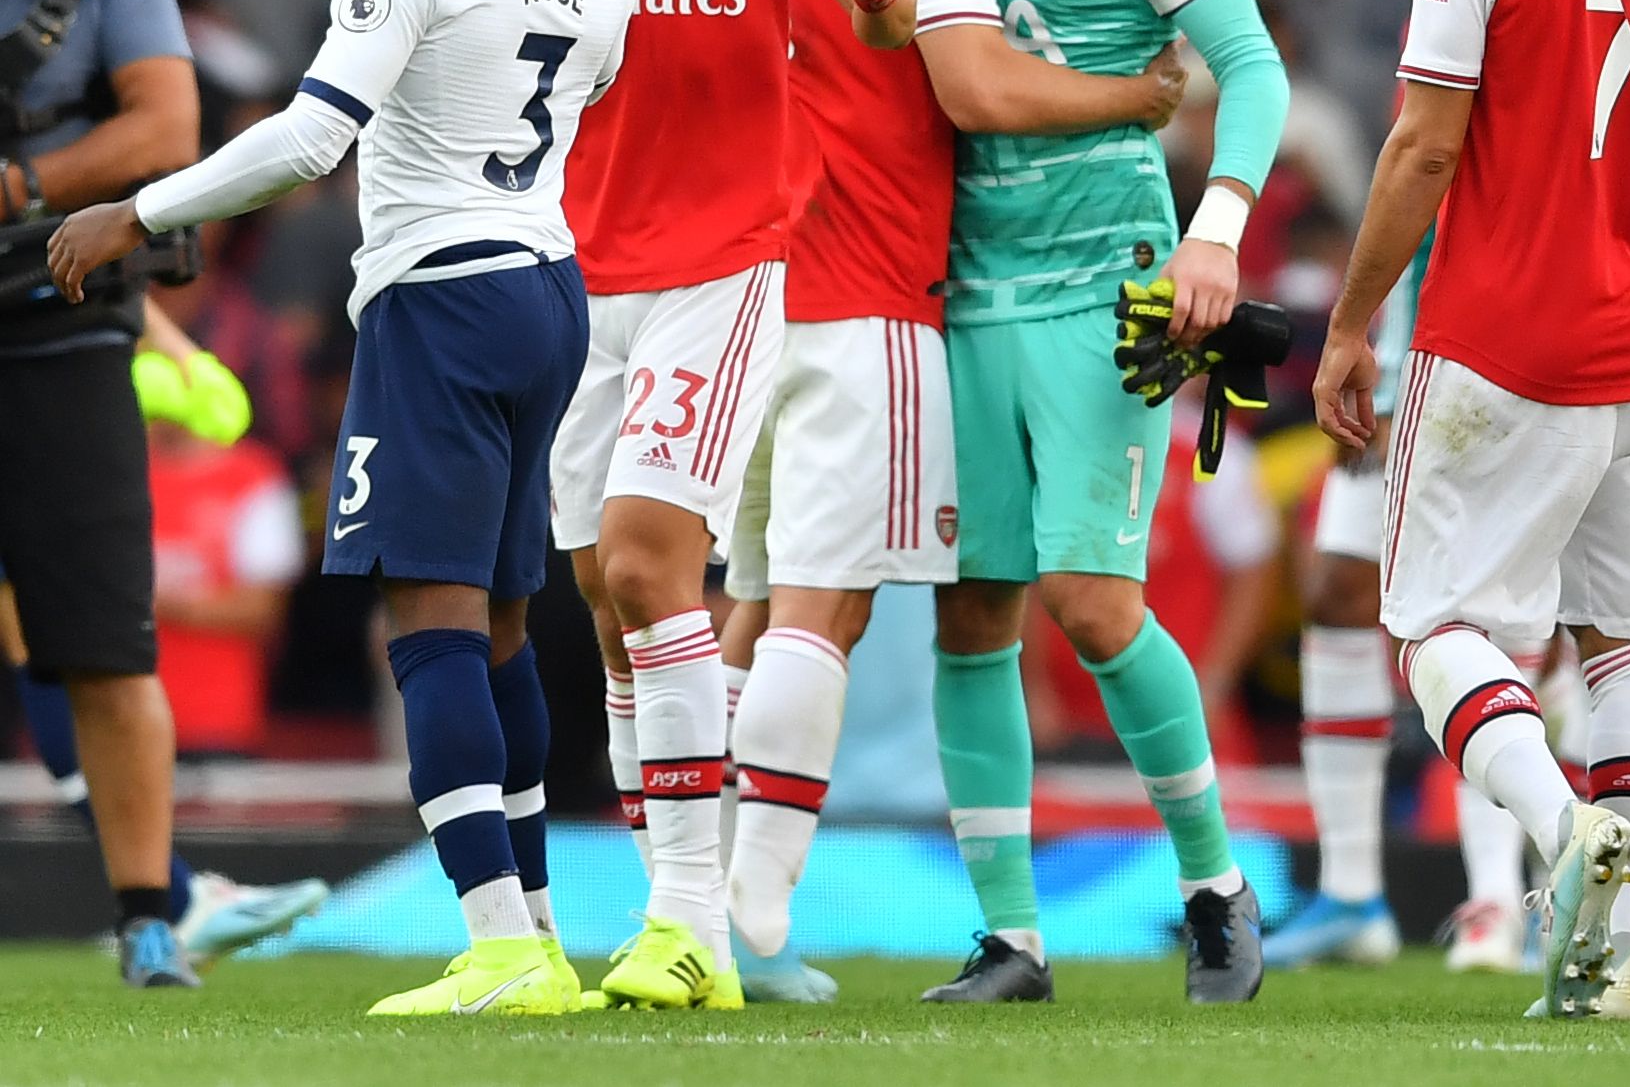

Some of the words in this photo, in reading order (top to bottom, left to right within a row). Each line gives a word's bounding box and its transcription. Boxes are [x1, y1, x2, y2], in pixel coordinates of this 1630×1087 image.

[482, 32, 579, 193] 3
[618, 367, 709, 439] 23
[339, 435, 379, 515] 3
[636, 457, 677, 471] adidas
[1126, 445, 1144, 520] 1
